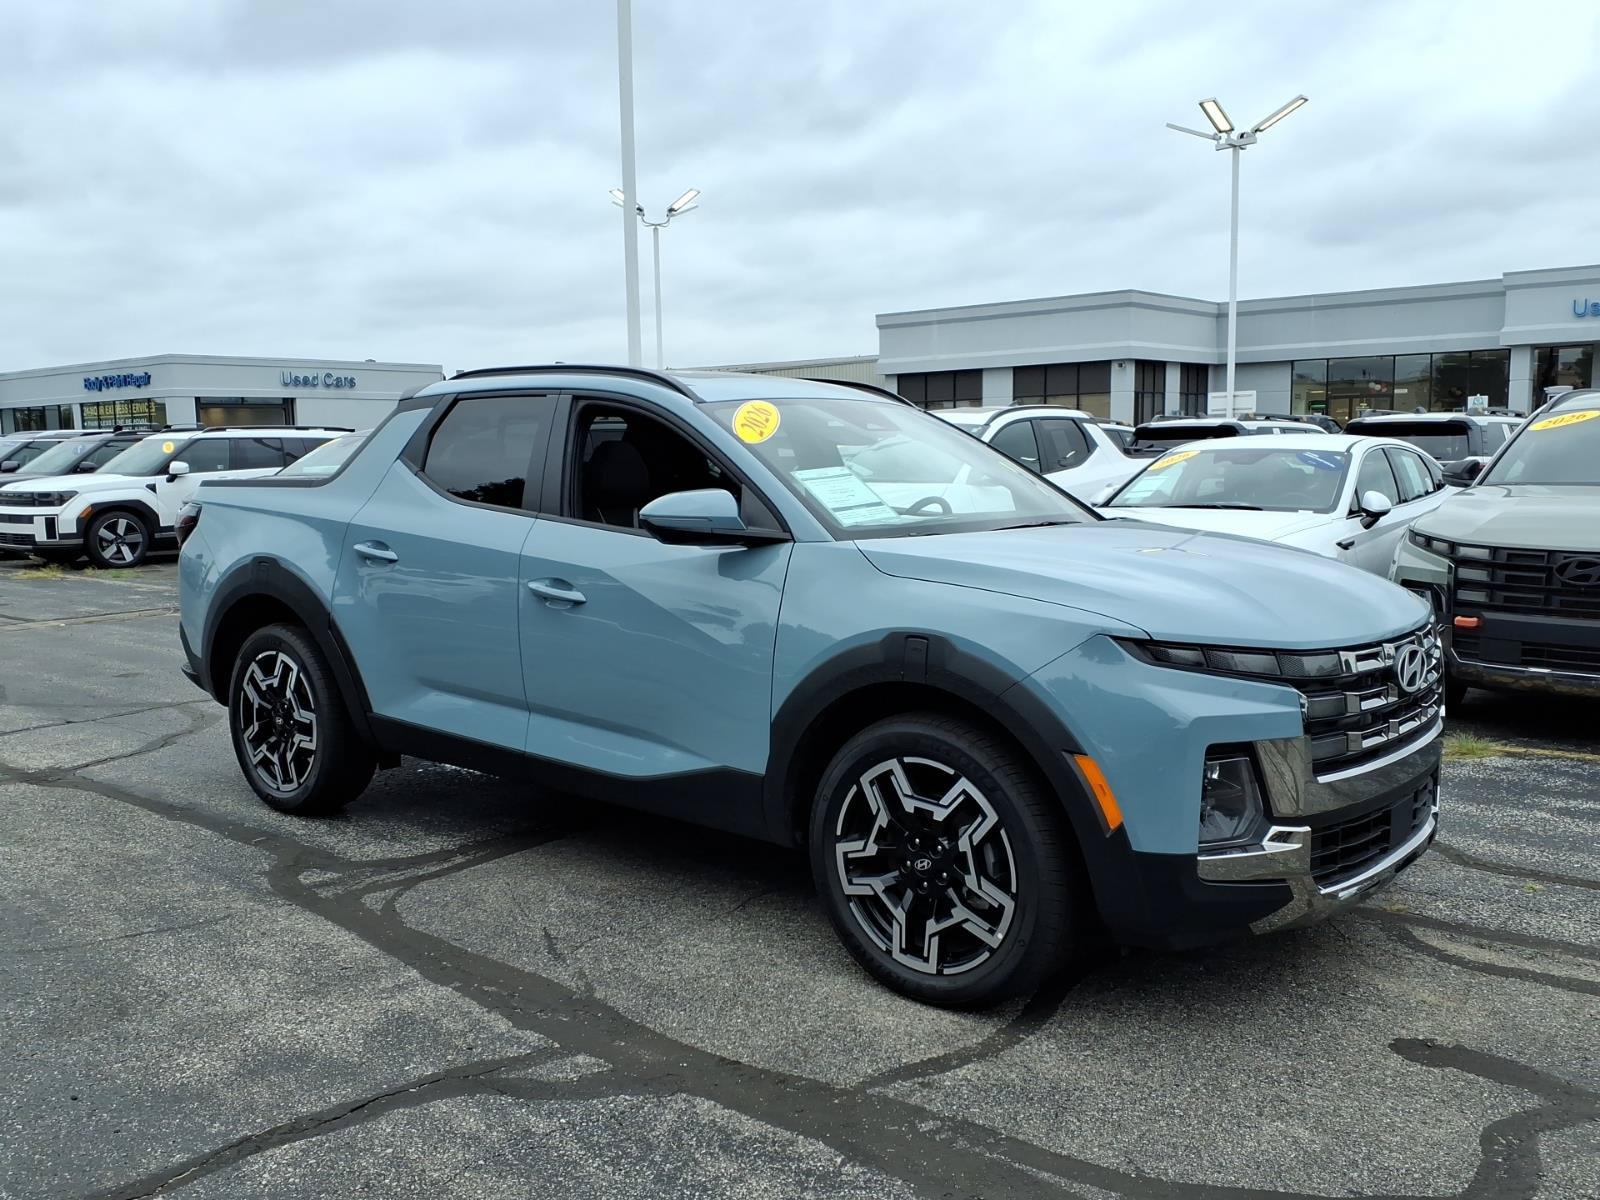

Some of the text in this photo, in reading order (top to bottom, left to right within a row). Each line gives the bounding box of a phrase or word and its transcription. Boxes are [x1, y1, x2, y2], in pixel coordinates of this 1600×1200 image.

[127, 371, 151, 389] Repair
[281, 371, 357, 388] Used Cars
